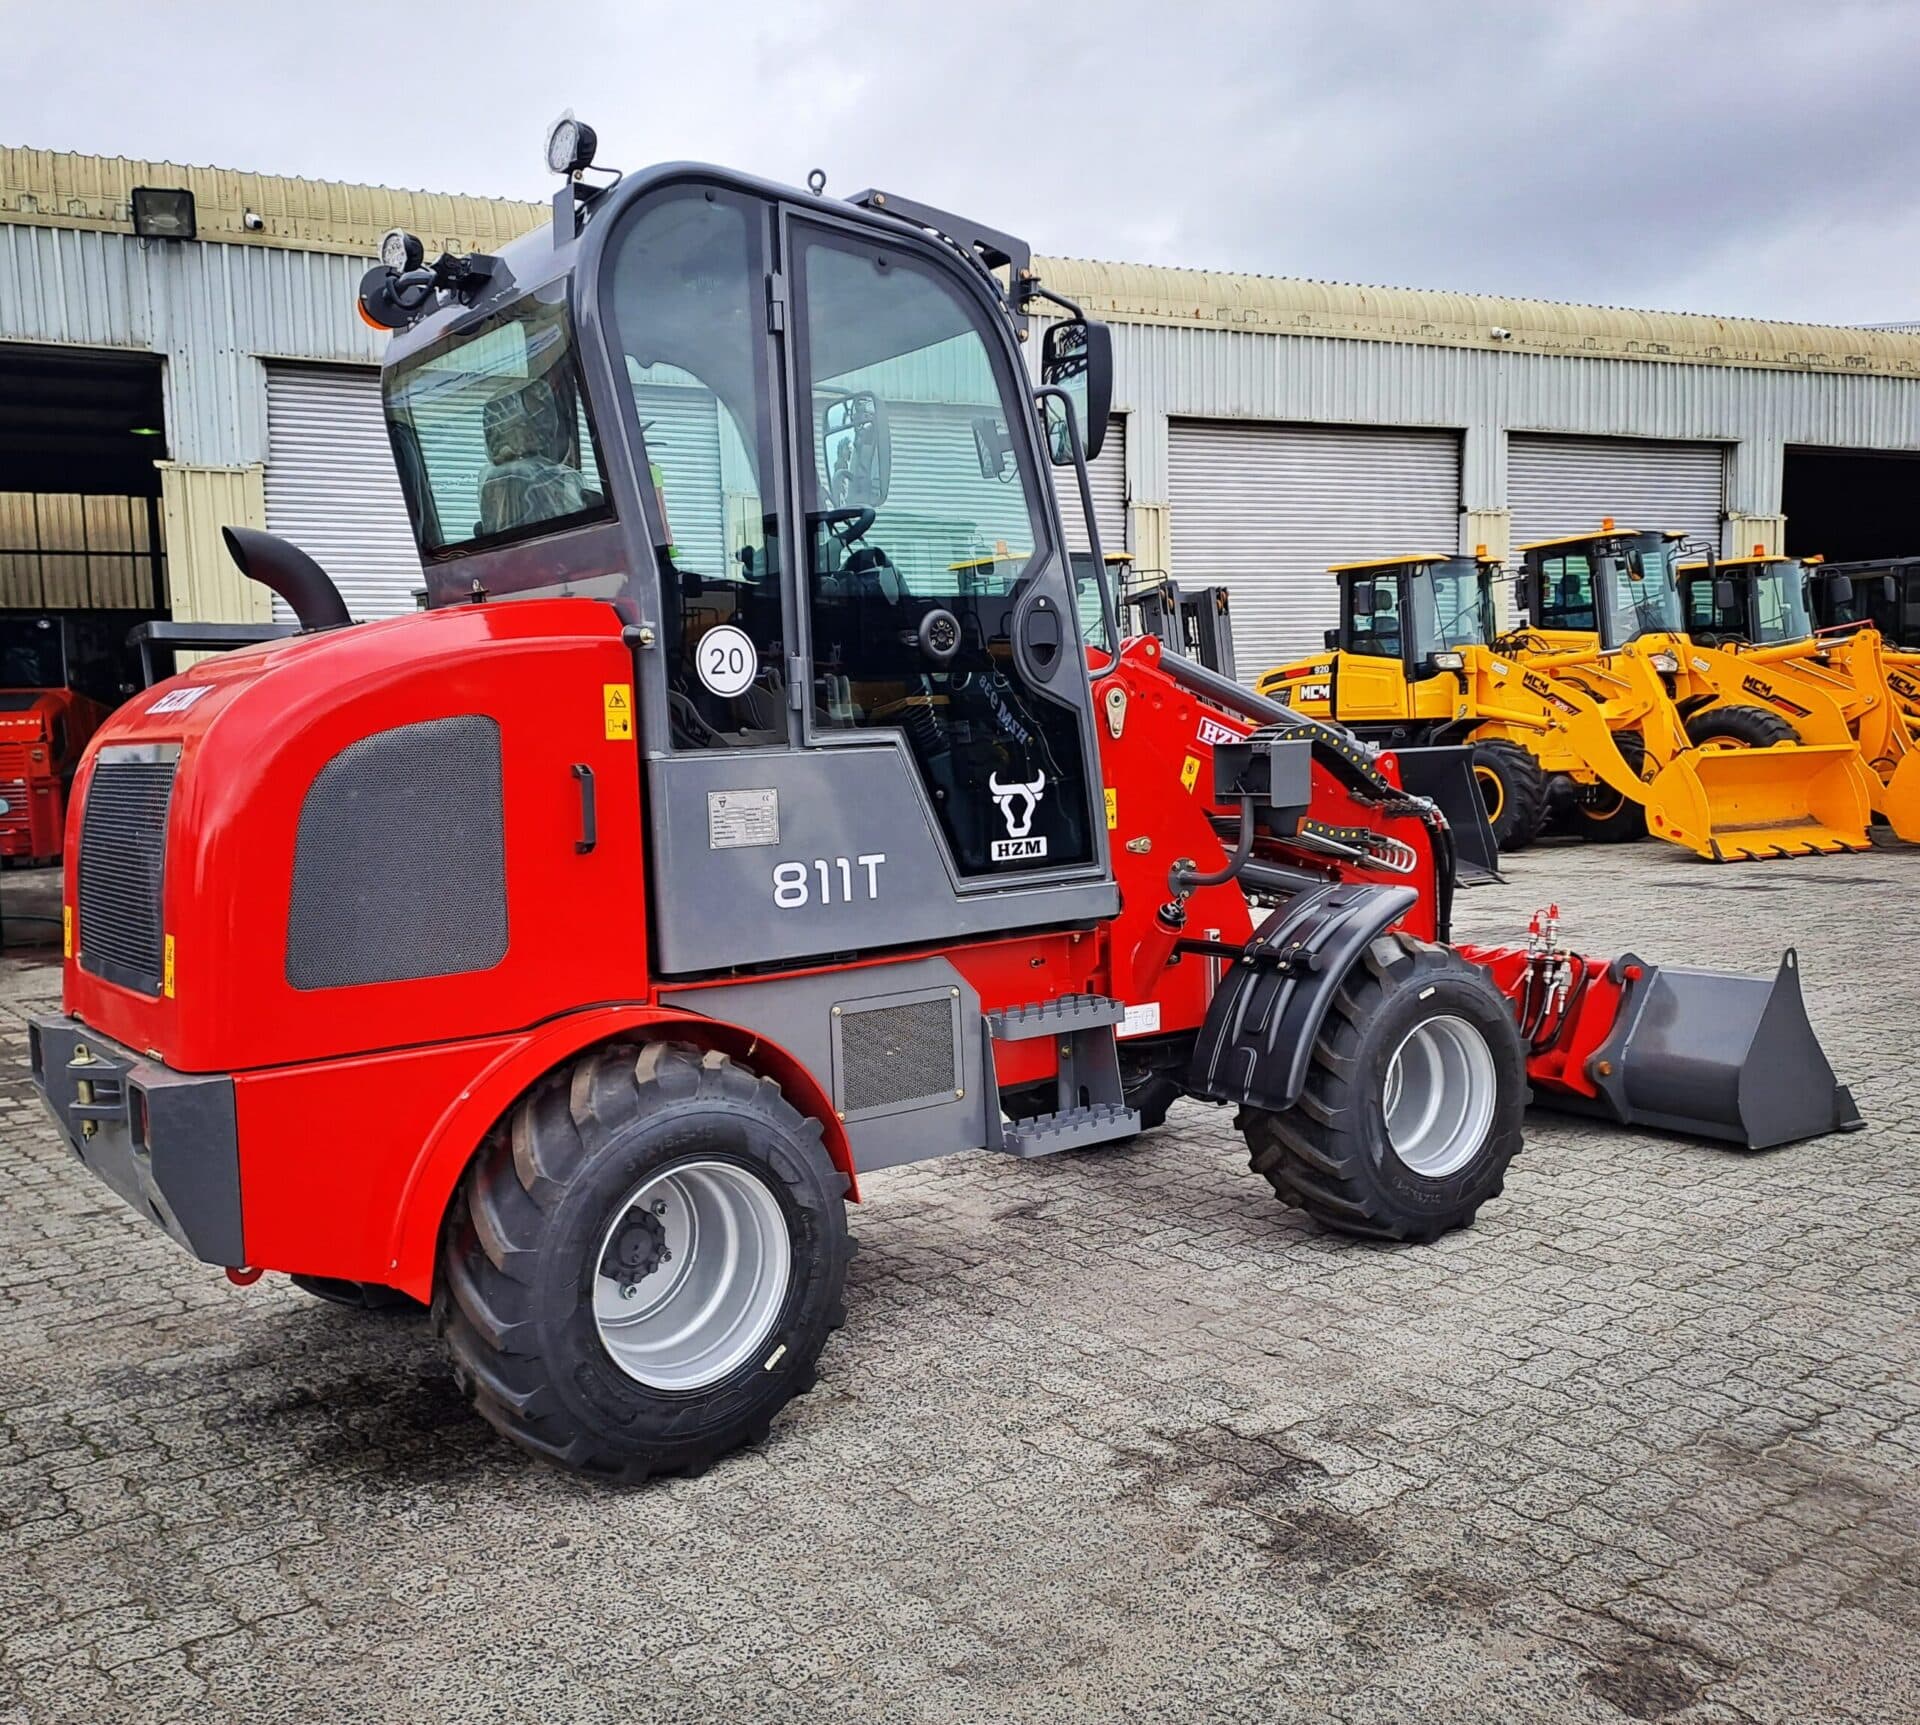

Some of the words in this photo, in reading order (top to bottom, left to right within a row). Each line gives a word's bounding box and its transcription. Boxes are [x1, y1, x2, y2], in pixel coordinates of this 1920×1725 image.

[710, 647, 744, 676] 20
[1314, 665, 1330, 675] 920
[1301, 685, 1330, 700] MCM
[1522, 671, 1550, 694] MCM
[1742, 674, 1773, 697] MCM
[1886, 672, 1916, 695] MCM
[997, 840, 1042, 858] HZM
[773, 853, 886, 909] 811T
